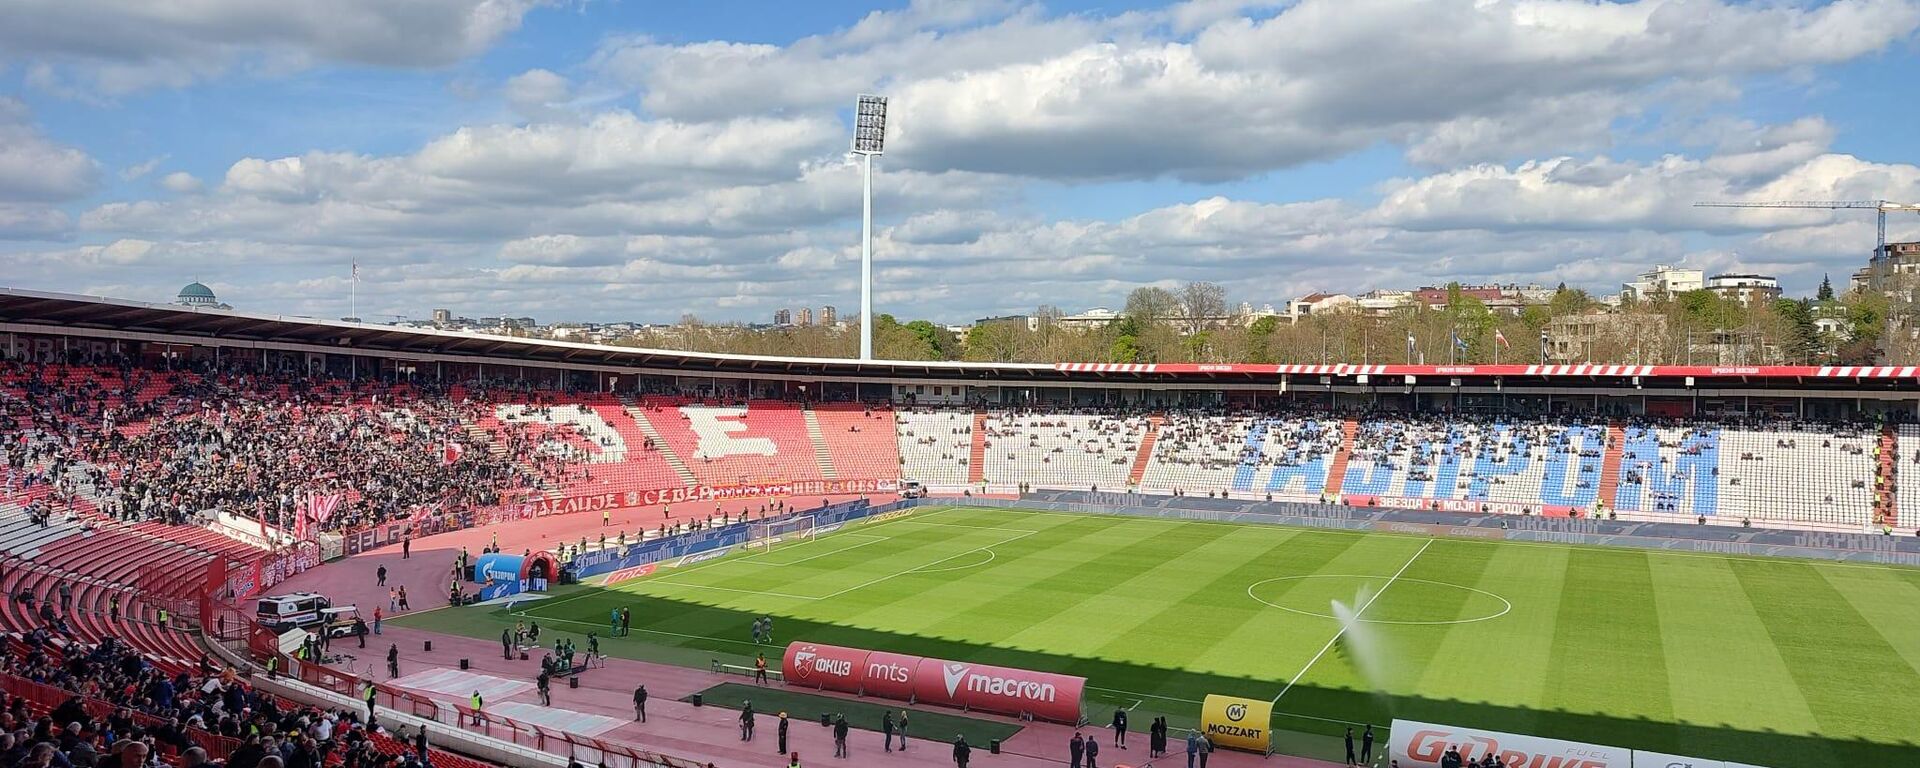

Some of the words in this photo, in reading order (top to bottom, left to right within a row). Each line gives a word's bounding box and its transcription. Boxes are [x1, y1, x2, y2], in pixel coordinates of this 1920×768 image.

[1379, 496, 1423, 509] ЗВЕЗДА
[1444, 501, 1476, 512] МОЈА
[610, 567, 647, 584] mts
[815, 658, 852, 677] ФКЦЗ
[868, 662, 909, 683] mts
[967, 673, 1056, 702] macron
[1207, 723, 1262, 740] MOZZART
[1565, 747, 1612, 760] FUEL
